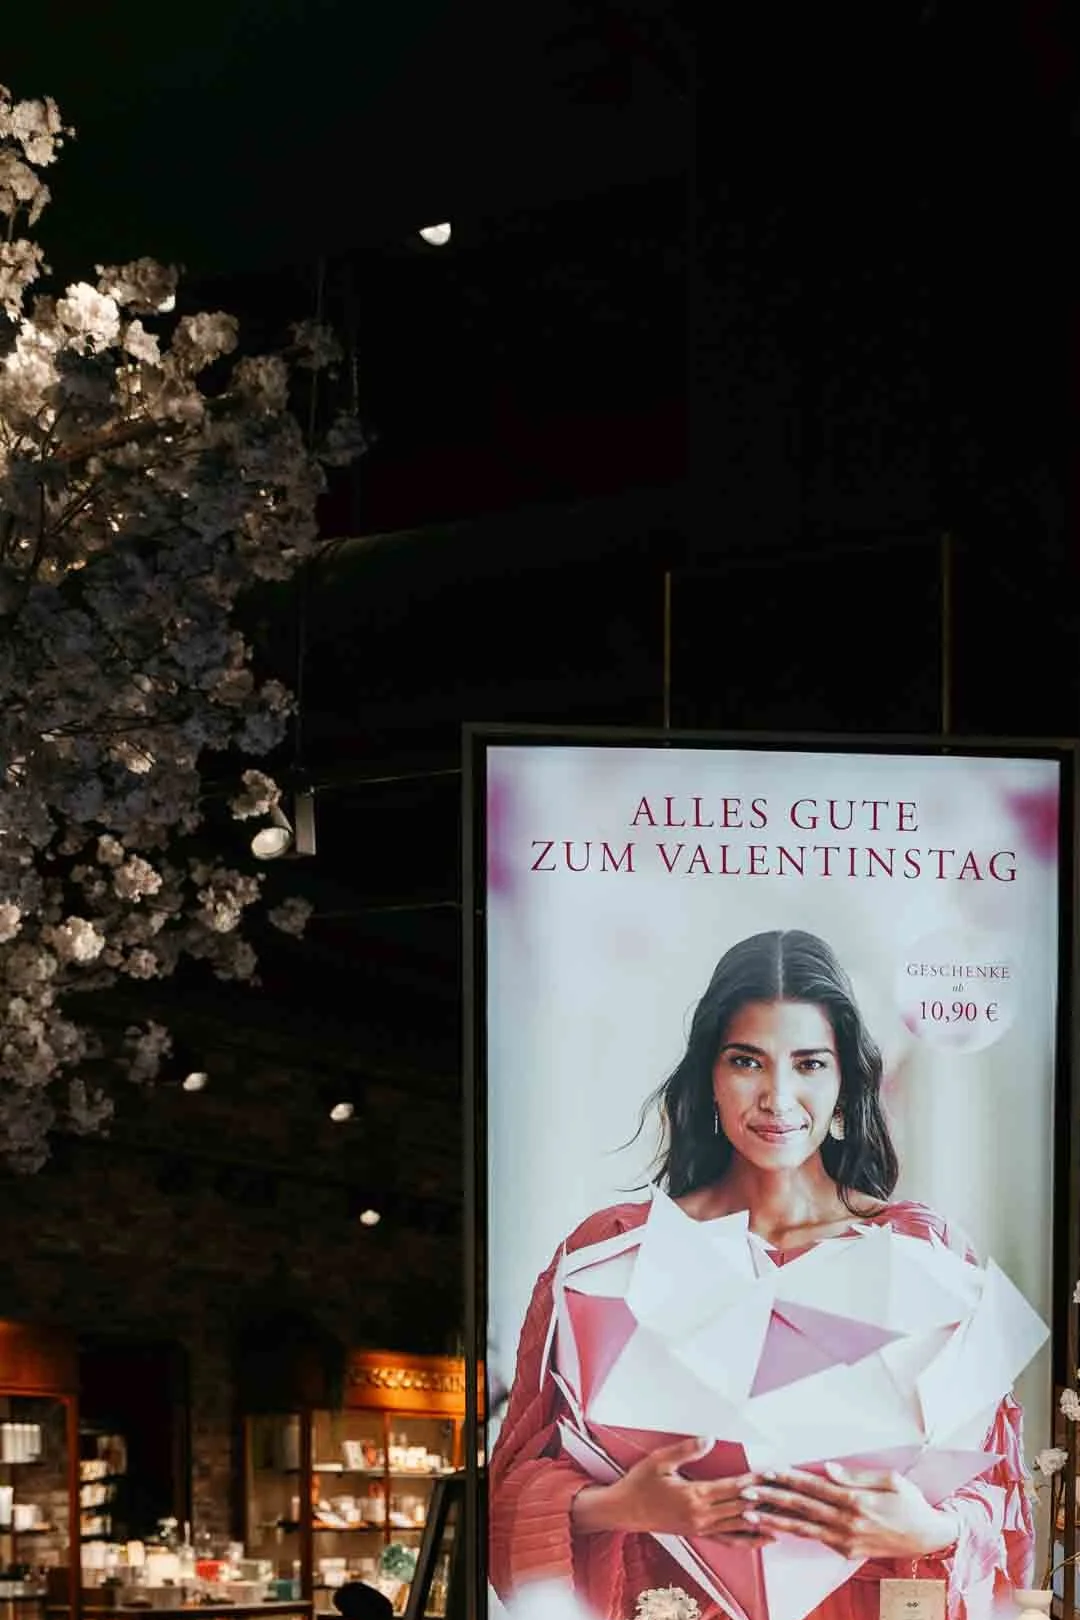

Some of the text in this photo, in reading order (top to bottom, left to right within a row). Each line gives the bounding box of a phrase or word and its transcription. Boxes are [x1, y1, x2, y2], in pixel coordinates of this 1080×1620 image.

[629, 796, 919, 834] ALLES GUTE
[530, 840, 1018, 883] ZUM VALENTINSTAG
[906, 963, 1011, 979] GESCHENKE
[919, 1000, 1000, 1023] 10,90 €
